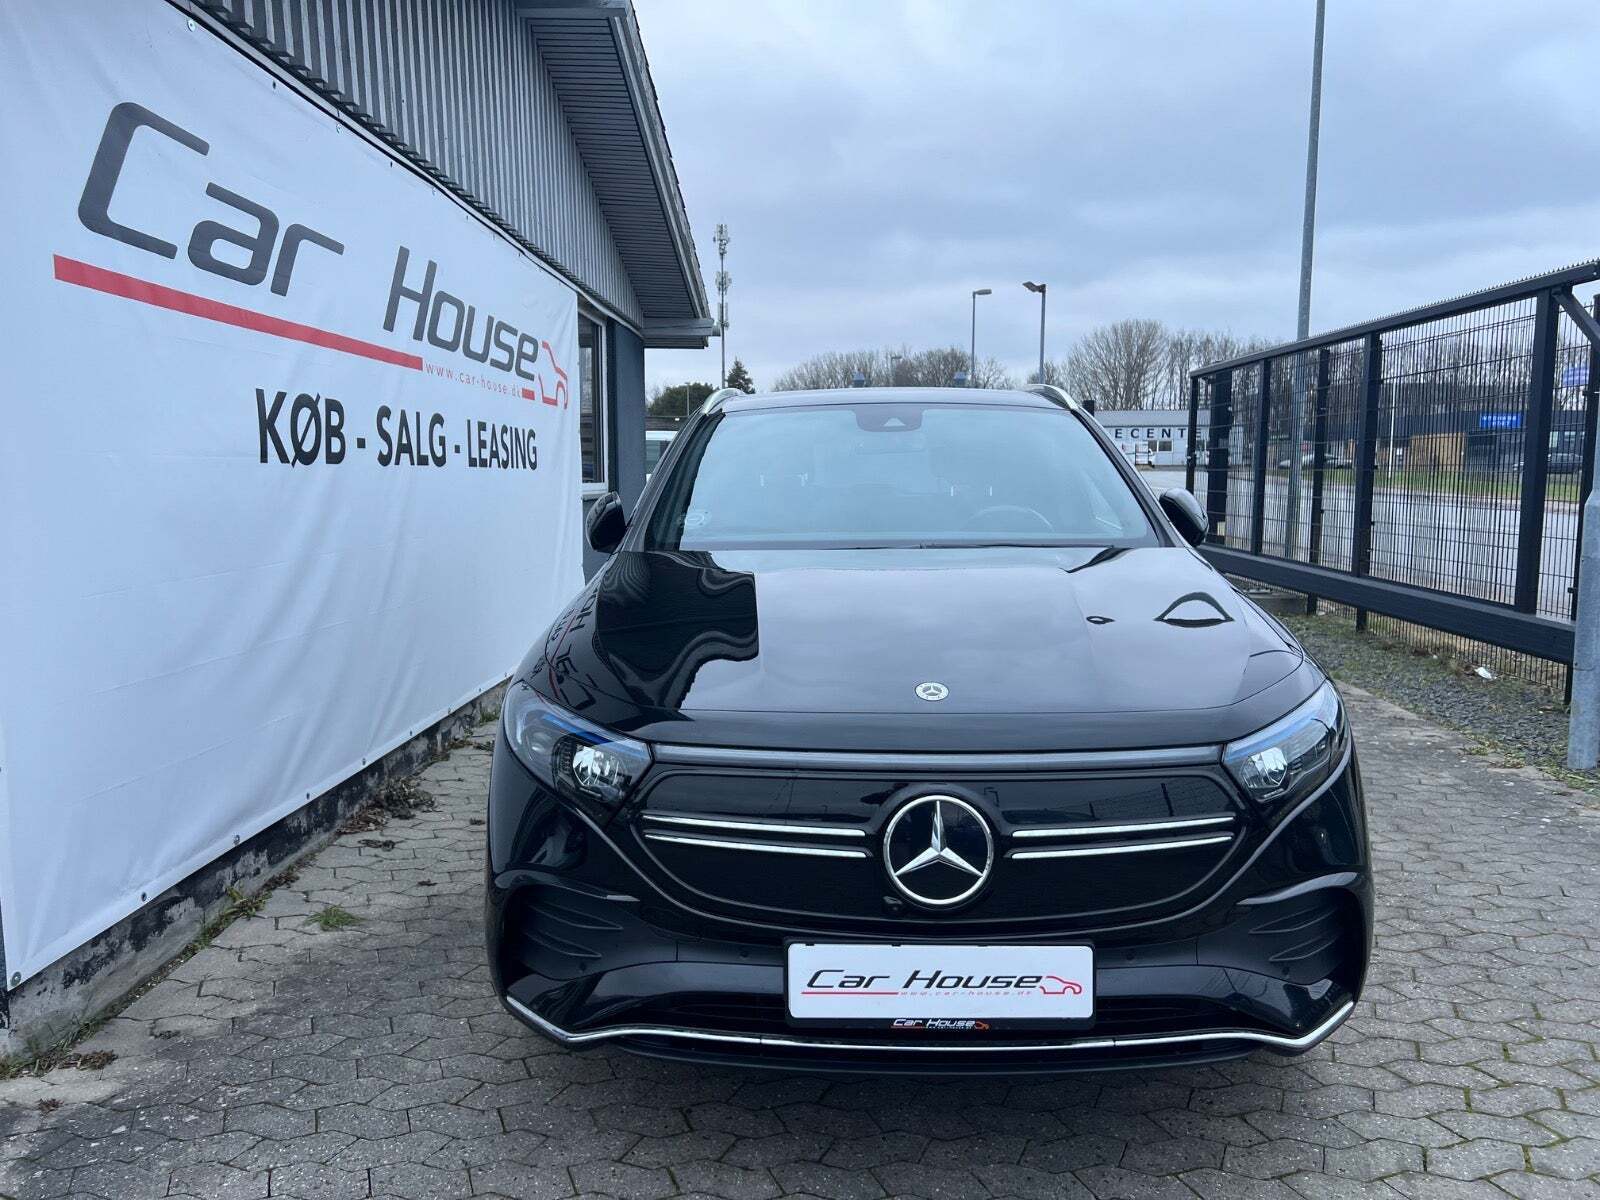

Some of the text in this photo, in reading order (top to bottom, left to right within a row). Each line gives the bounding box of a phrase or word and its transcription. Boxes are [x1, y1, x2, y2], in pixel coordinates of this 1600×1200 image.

[78, 102, 539, 381] Car House
[255, 388, 346, 468] KØB
[376, 405, 447, 467] SALG
[466, 419, 538, 471] LEASING
[807, 969, 1043, 989] Car House
[893, 1018, 976, 1027] Car House
